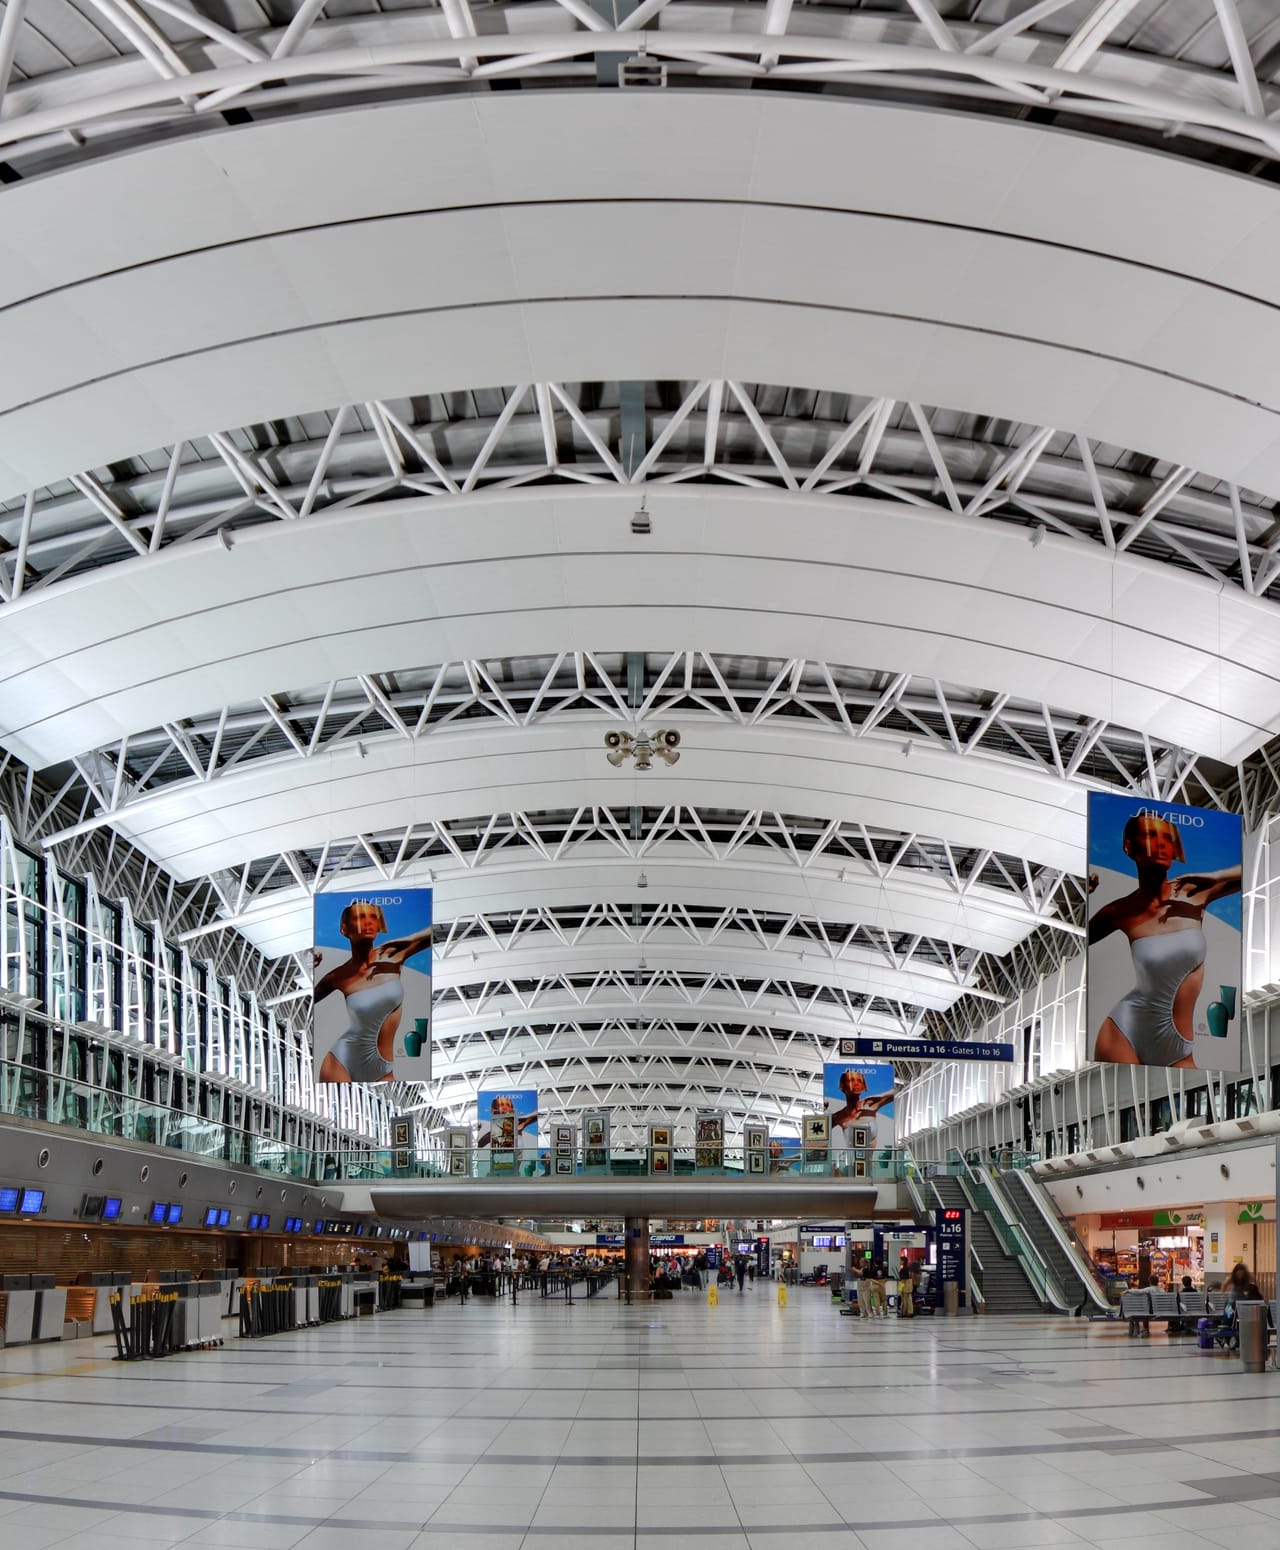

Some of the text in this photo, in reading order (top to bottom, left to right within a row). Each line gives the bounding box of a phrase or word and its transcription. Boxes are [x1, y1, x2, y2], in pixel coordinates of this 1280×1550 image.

[1130, 807, 1204, 828] SHISEIDO
[345, 896, 403, 906] SHISEIDO
[886, 1043, 920, 1053] Puertas
[936, 1046, 946, 1054] 16
[952, 1046, 974, 1055] Gates
[982, 1048, 990, 1056] to
[992, 1048, 1001, 1056] 16
